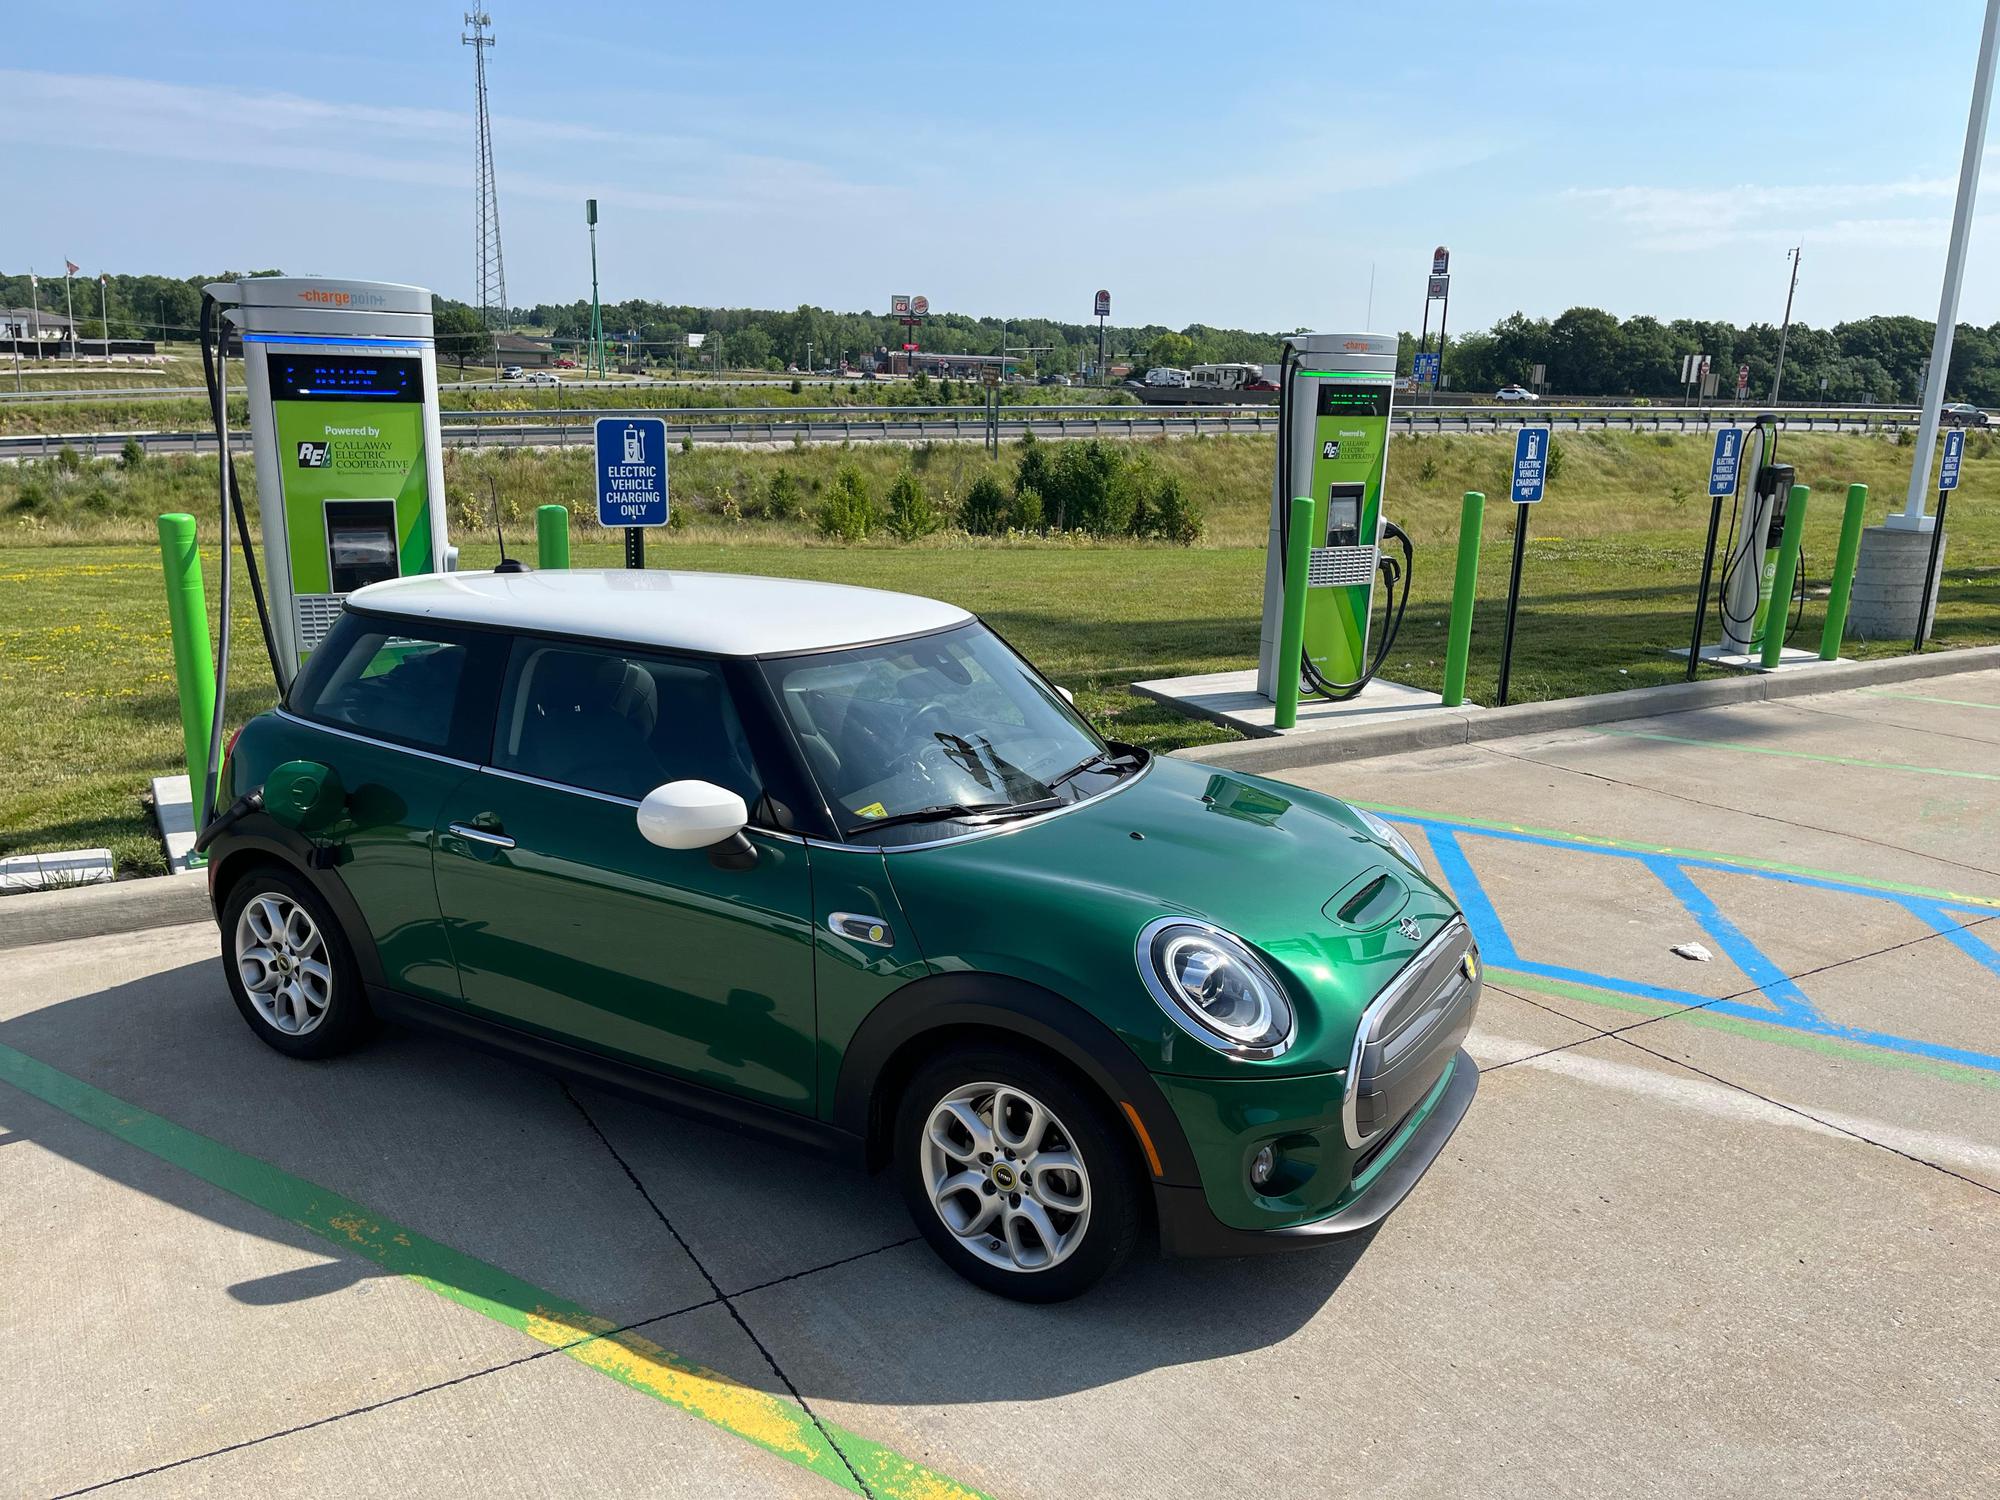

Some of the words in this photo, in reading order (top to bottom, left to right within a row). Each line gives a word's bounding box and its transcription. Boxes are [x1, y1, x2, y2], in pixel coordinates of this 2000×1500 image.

[325, 425, 366, 436] Powered
[368, 426, 380, 438] by
[334, 441, 393, 450] CALLAWAY
[335, 451, 386, 459] ELECTRIC
[336, 460, 409, 469] COOPERATIVE
[1519, 460, 1541, 469] ELECTRIC
[608, 466, 657, 478] ELECTRIC
[1519, 469, 1539, 477] VEHICLE
[611, 479, 654, 490] VEHICLE
[1515, 478, 1541, 487] CHARGING
[1520, 487, 1534, 496] ONLY
[606, 492, 660, 503] CHARGING
[620, 504, 647, 516] ONLY
